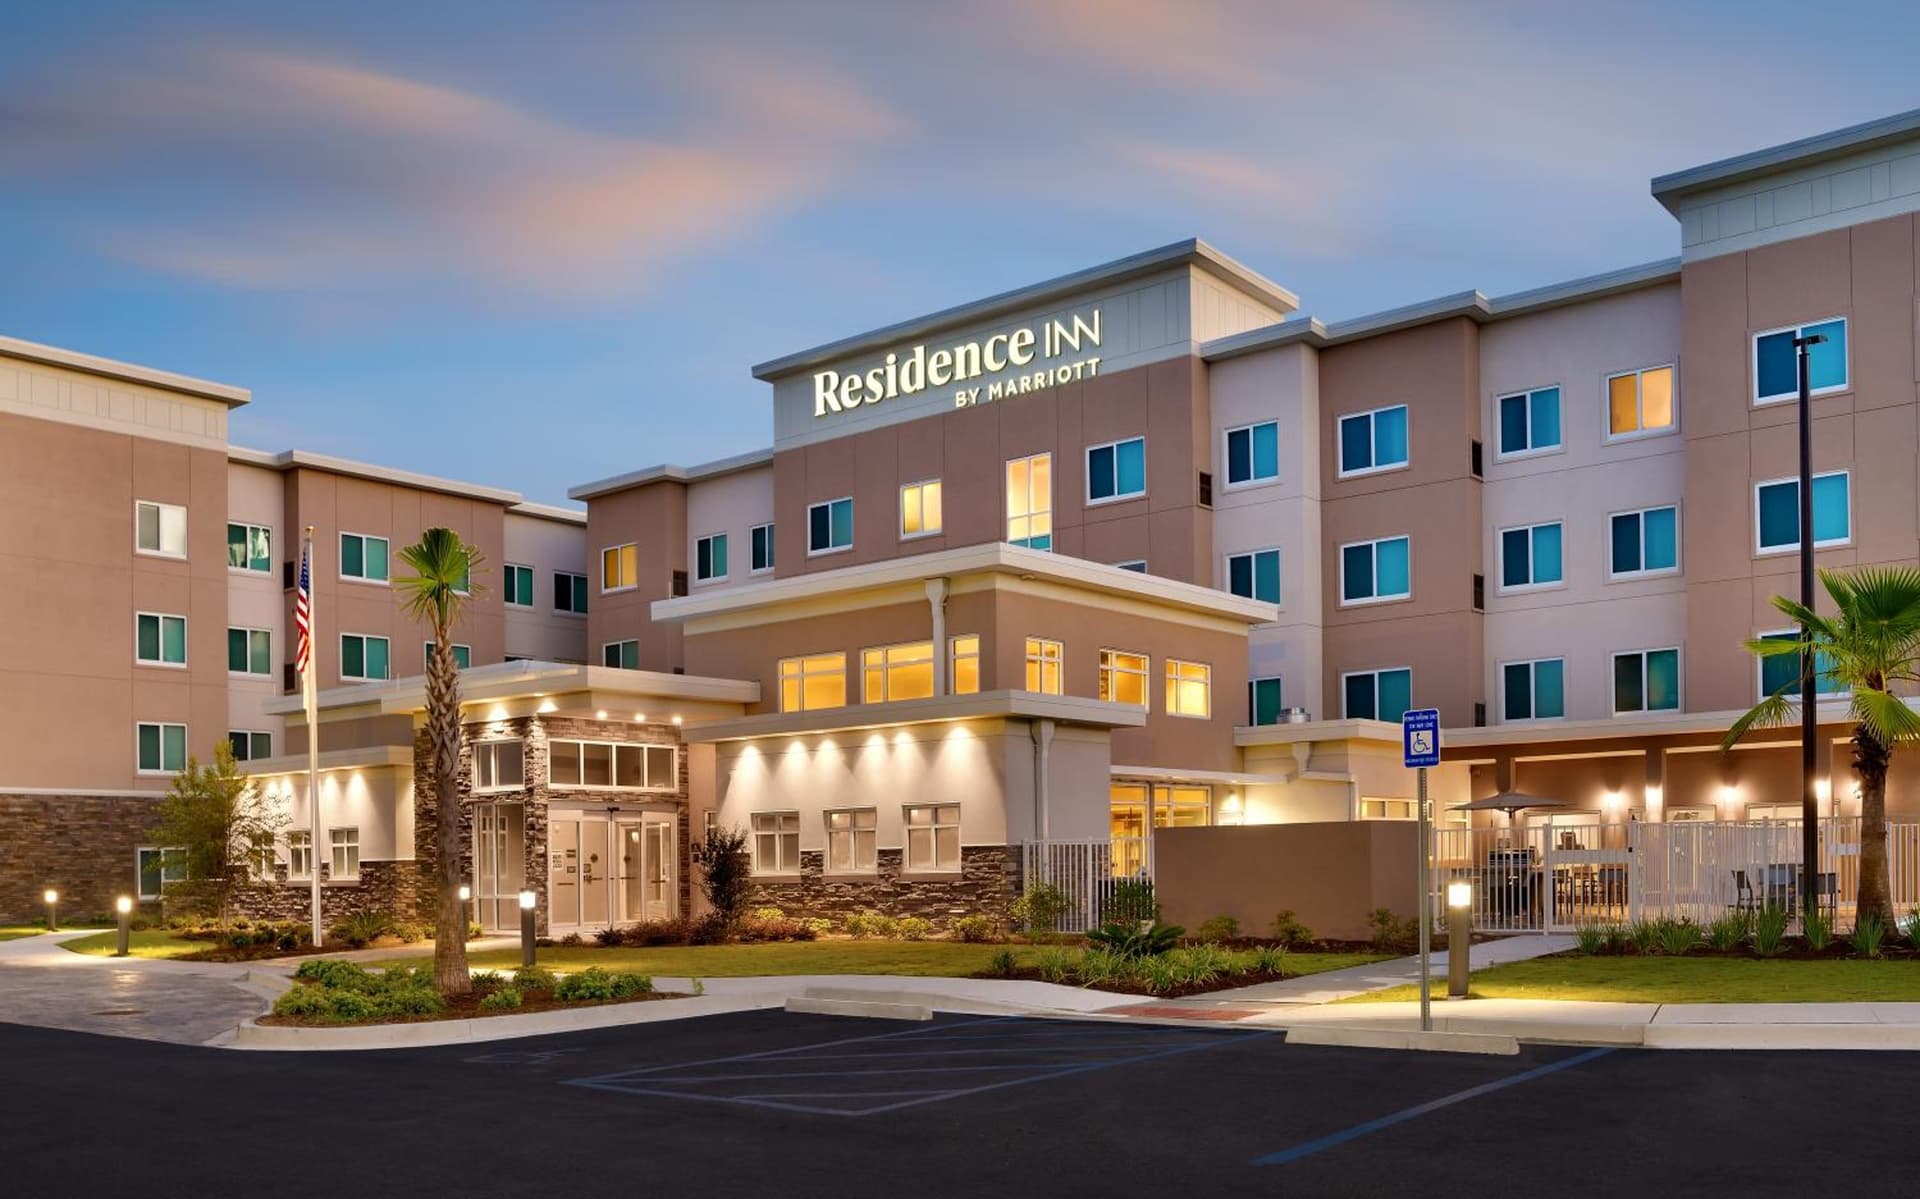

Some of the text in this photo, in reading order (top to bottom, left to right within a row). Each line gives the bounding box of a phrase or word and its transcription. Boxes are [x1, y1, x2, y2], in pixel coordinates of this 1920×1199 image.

[814, 309, 1101, 417] Residence INN
[955, 357, 1102, 408] BY MARRIOTT
